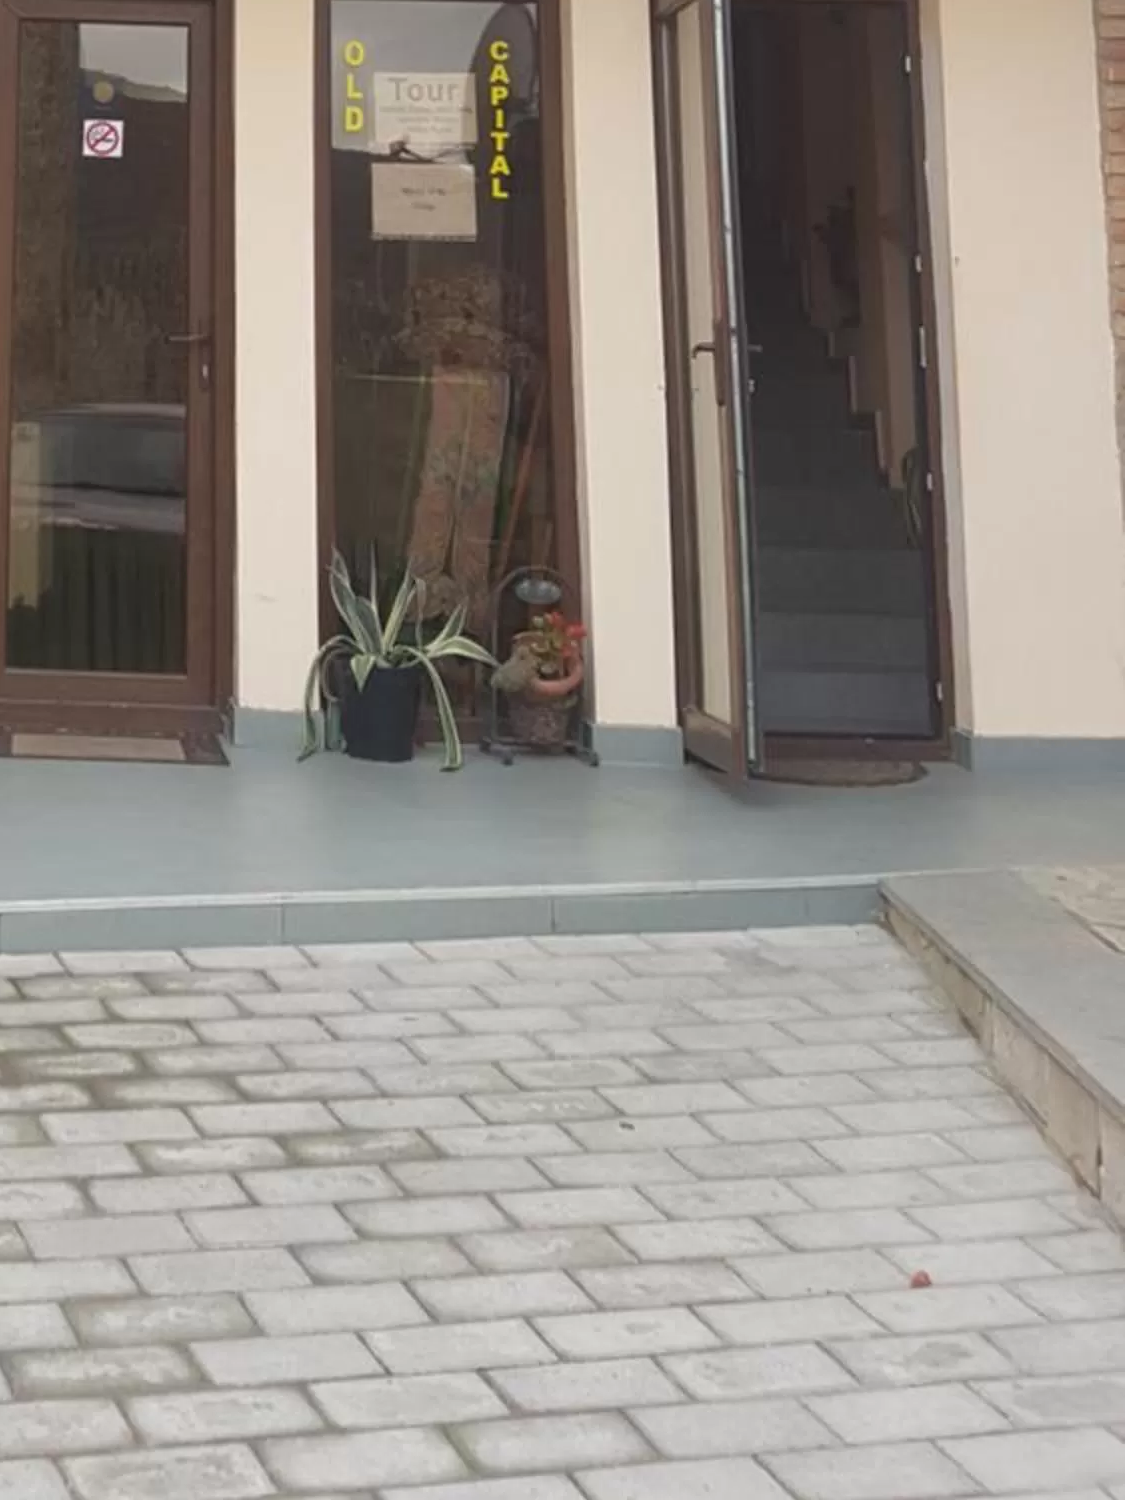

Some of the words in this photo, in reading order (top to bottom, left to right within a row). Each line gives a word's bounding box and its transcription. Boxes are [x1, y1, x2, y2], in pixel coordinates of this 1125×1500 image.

[344, 40, 365, 132] OLD
[388, 78, 459, 101] Tour
[489, 40, 511, 199] CAPITAL
